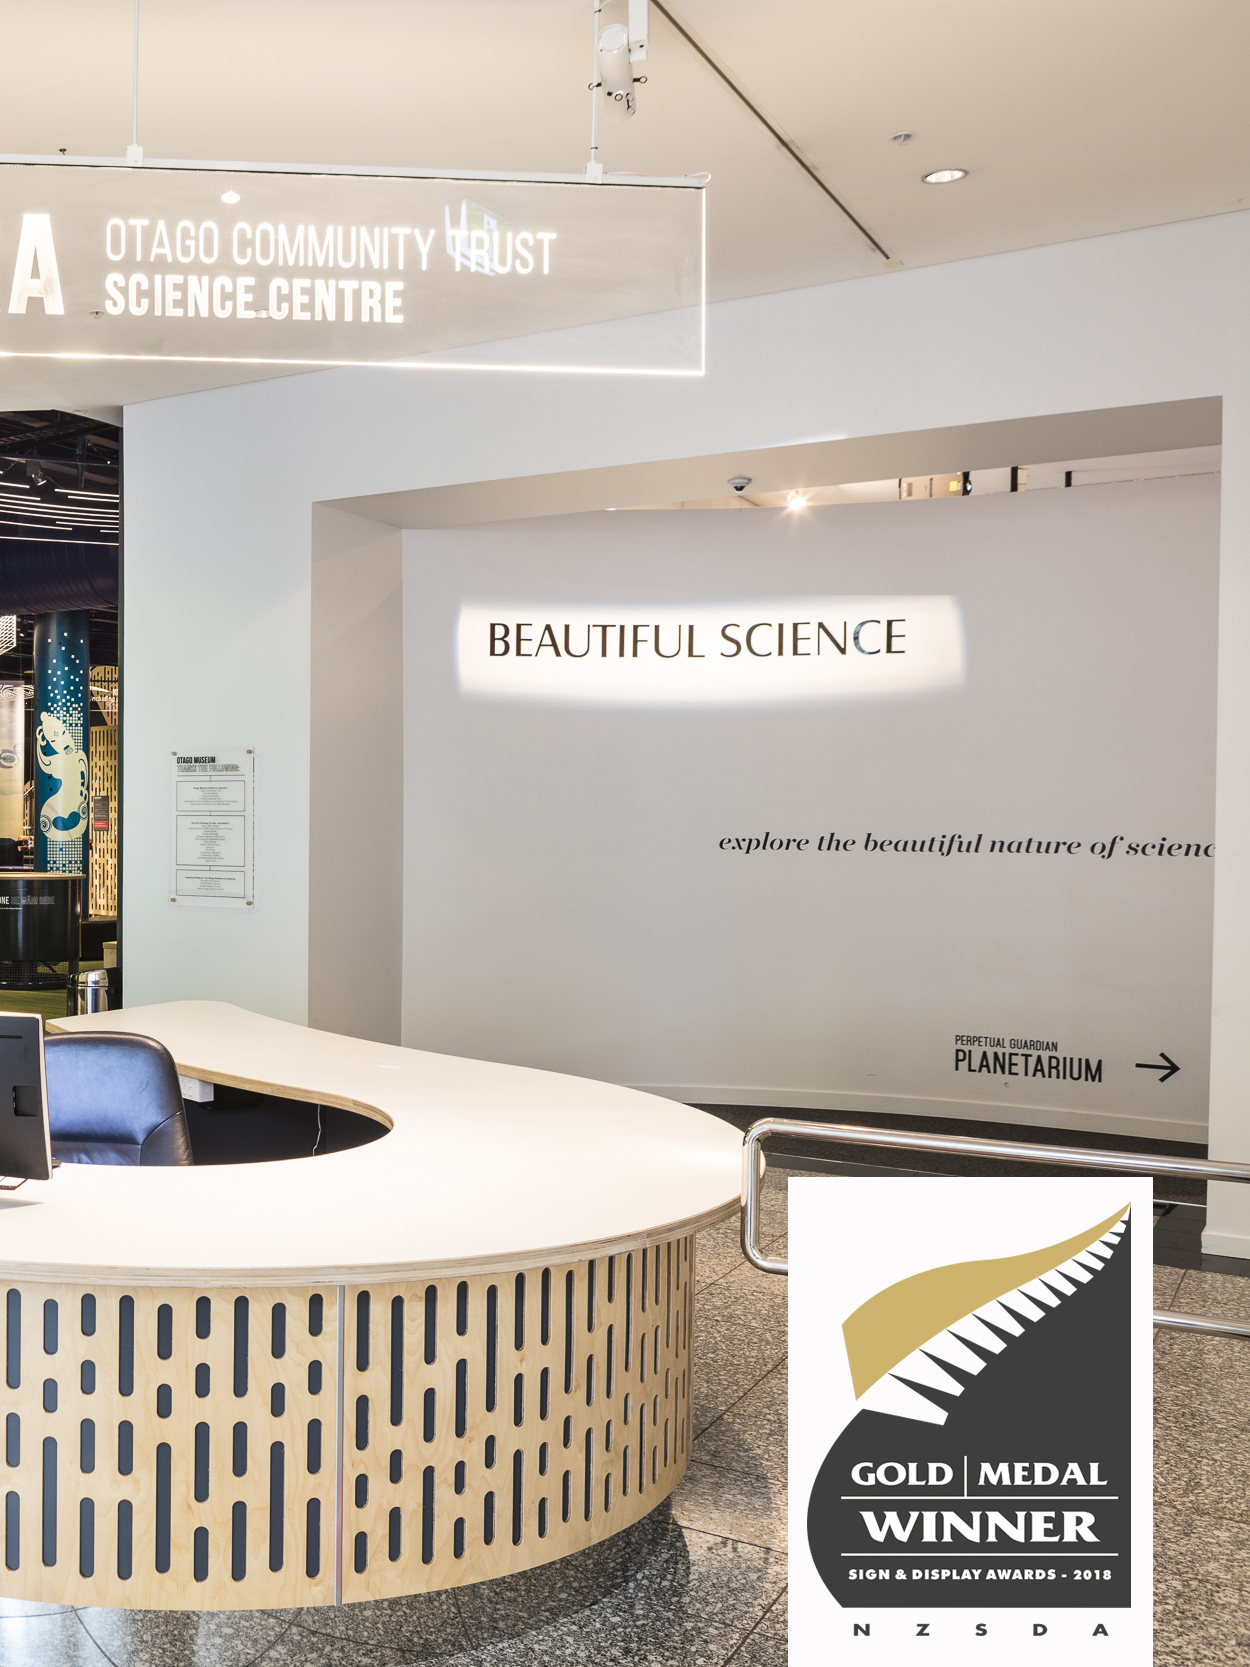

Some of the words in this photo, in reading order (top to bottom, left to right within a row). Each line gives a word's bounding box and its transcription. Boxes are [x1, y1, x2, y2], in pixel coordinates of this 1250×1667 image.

[106, 217, 219, 264] OTAGO
[232, 221, 436, 271] COMMUNITY
[447, 229, 557, 275] TRUST
[104, 272, 256, 319] SCIENCE
[268, 277, 405, 324] CENTRE
[488, 622, 706, 659] BEAUTIFUL
[719, 618, 907, 658] SCIENCE
[176, 756, 192, 764] OTAGO
[194, 756, 215, 764] MUSEUM
[718, 831, 810, 857] explore
[817, 831, 856, 853] the
[864, 832, 983, 857] beautiful
[989, 837, 1082, 856] nature
[1090, 835, 1125, 860] of
[1125, 836, 1215, 859] scienc
[955, 1034, 1007, 1049] PERPETUAL
[1009, 1038, 1058, 1052] GUARDIAN
[954, 1048, 1103, 1083] PLANETARIUM
